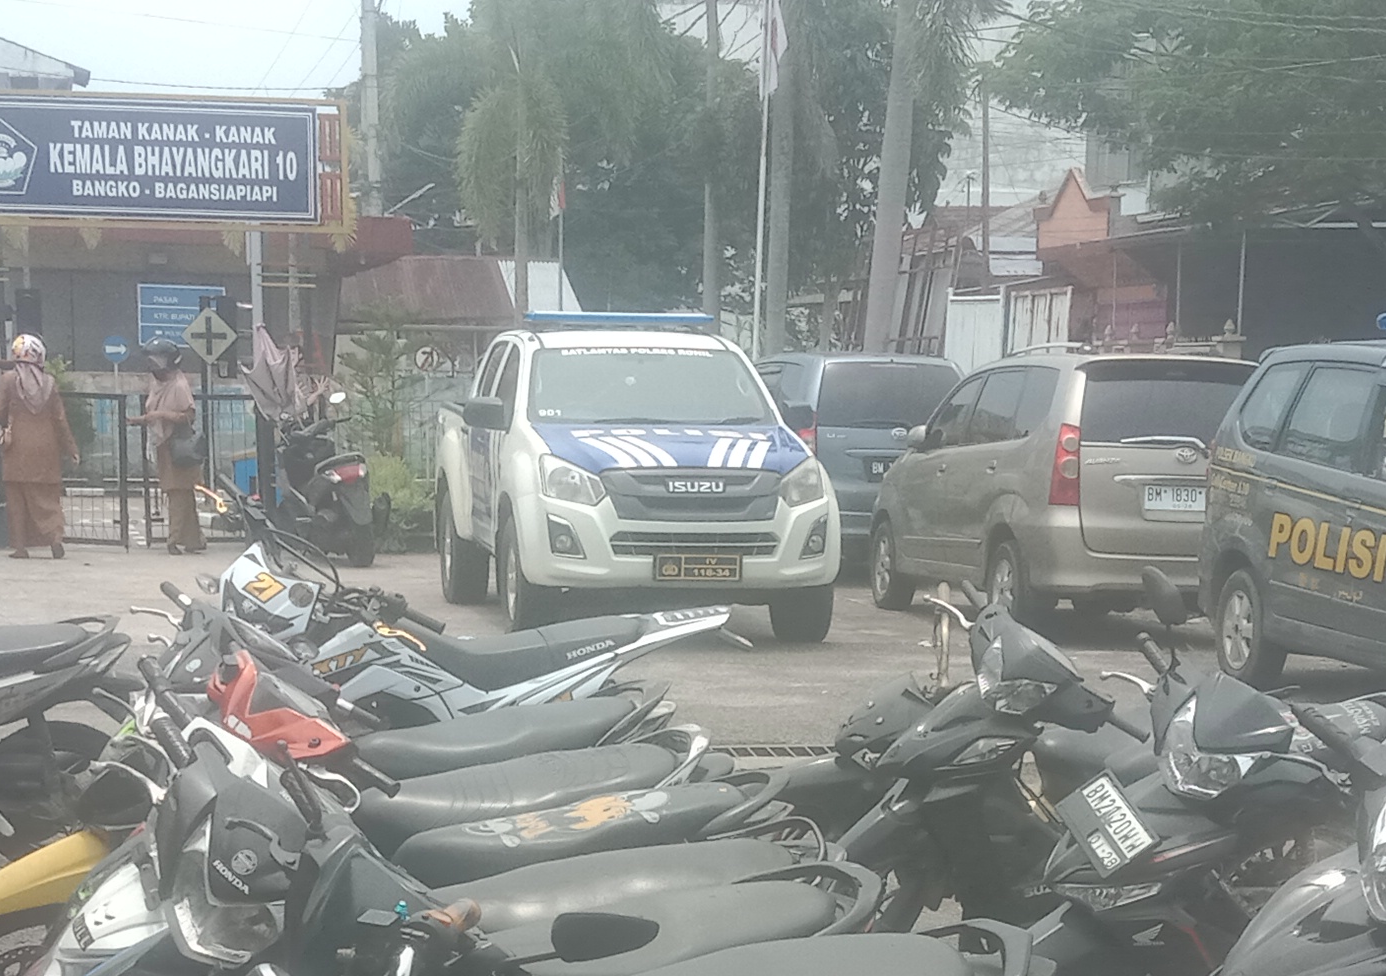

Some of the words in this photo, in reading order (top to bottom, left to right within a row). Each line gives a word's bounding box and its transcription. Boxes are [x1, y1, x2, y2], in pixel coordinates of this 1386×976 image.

[70, 120, 132, 140] TAMAN
[137, 122, 199, 142] KANAK
[215, 125, 276, 145] KANAK
[48, 142, 129, 176] KEMALA
[133, 145, 270, 180] BHAYANGKARI
[276, 151, 297, 181] 10
[72, 179, 140, 198] BANGKO
[154, 182, 278, 202] BAGANSIAPIAPI
[153, 296, 178, 304] PASAR
[538, 409, 562, 417] 901
[570, 428, 768, 440] POLISI
[872, 461, 884, 474] BM
[668, 481, 724, 493] ISUZU
[1147, 486, 1162, 501] BM
[1172, 488, 1197, 503] 1830
[705, 557, 717, 566] IV
[242, 571, 287, 604] 21
[566, 639, 616, 660] HONDA
[212, 859, 250, 895] HONDA
